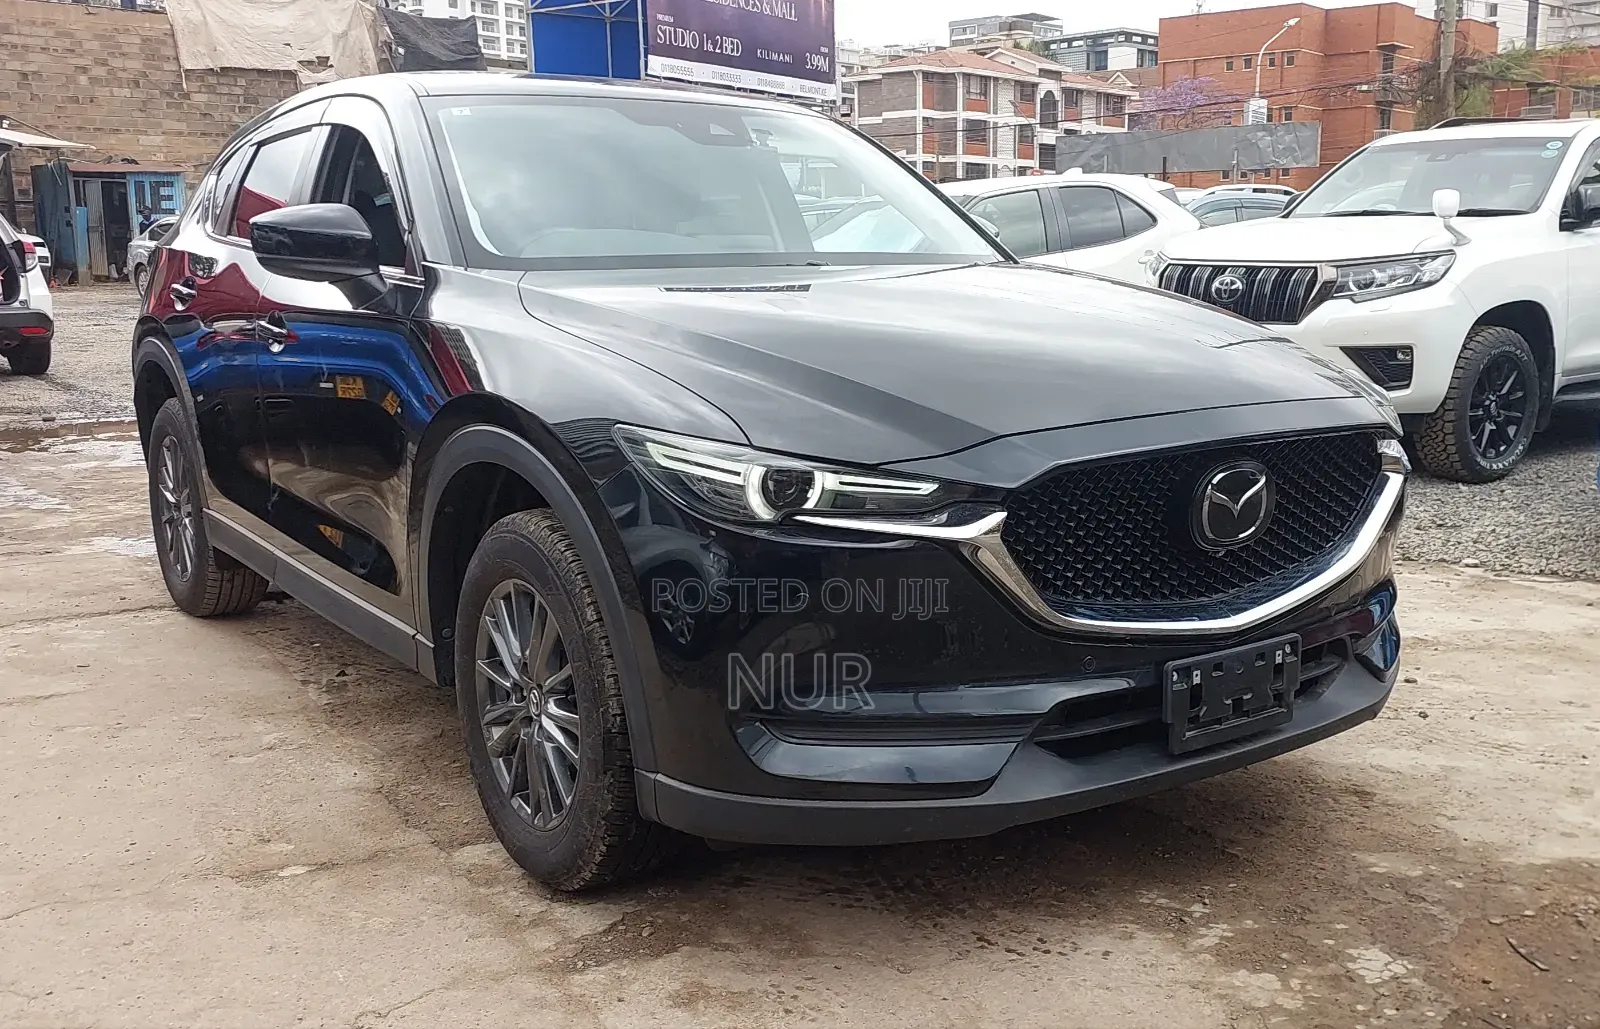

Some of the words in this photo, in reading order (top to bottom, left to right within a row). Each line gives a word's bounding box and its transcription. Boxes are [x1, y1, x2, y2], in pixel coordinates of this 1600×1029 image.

[772, 0, 798, 21] MALL
[657, 24, 699, 49] STUDIO
[757, 48, 793, 64] KILIMANI
[805, 52, 829, 73] 3.99M
[660, 63, 694, 77] 0118055555
